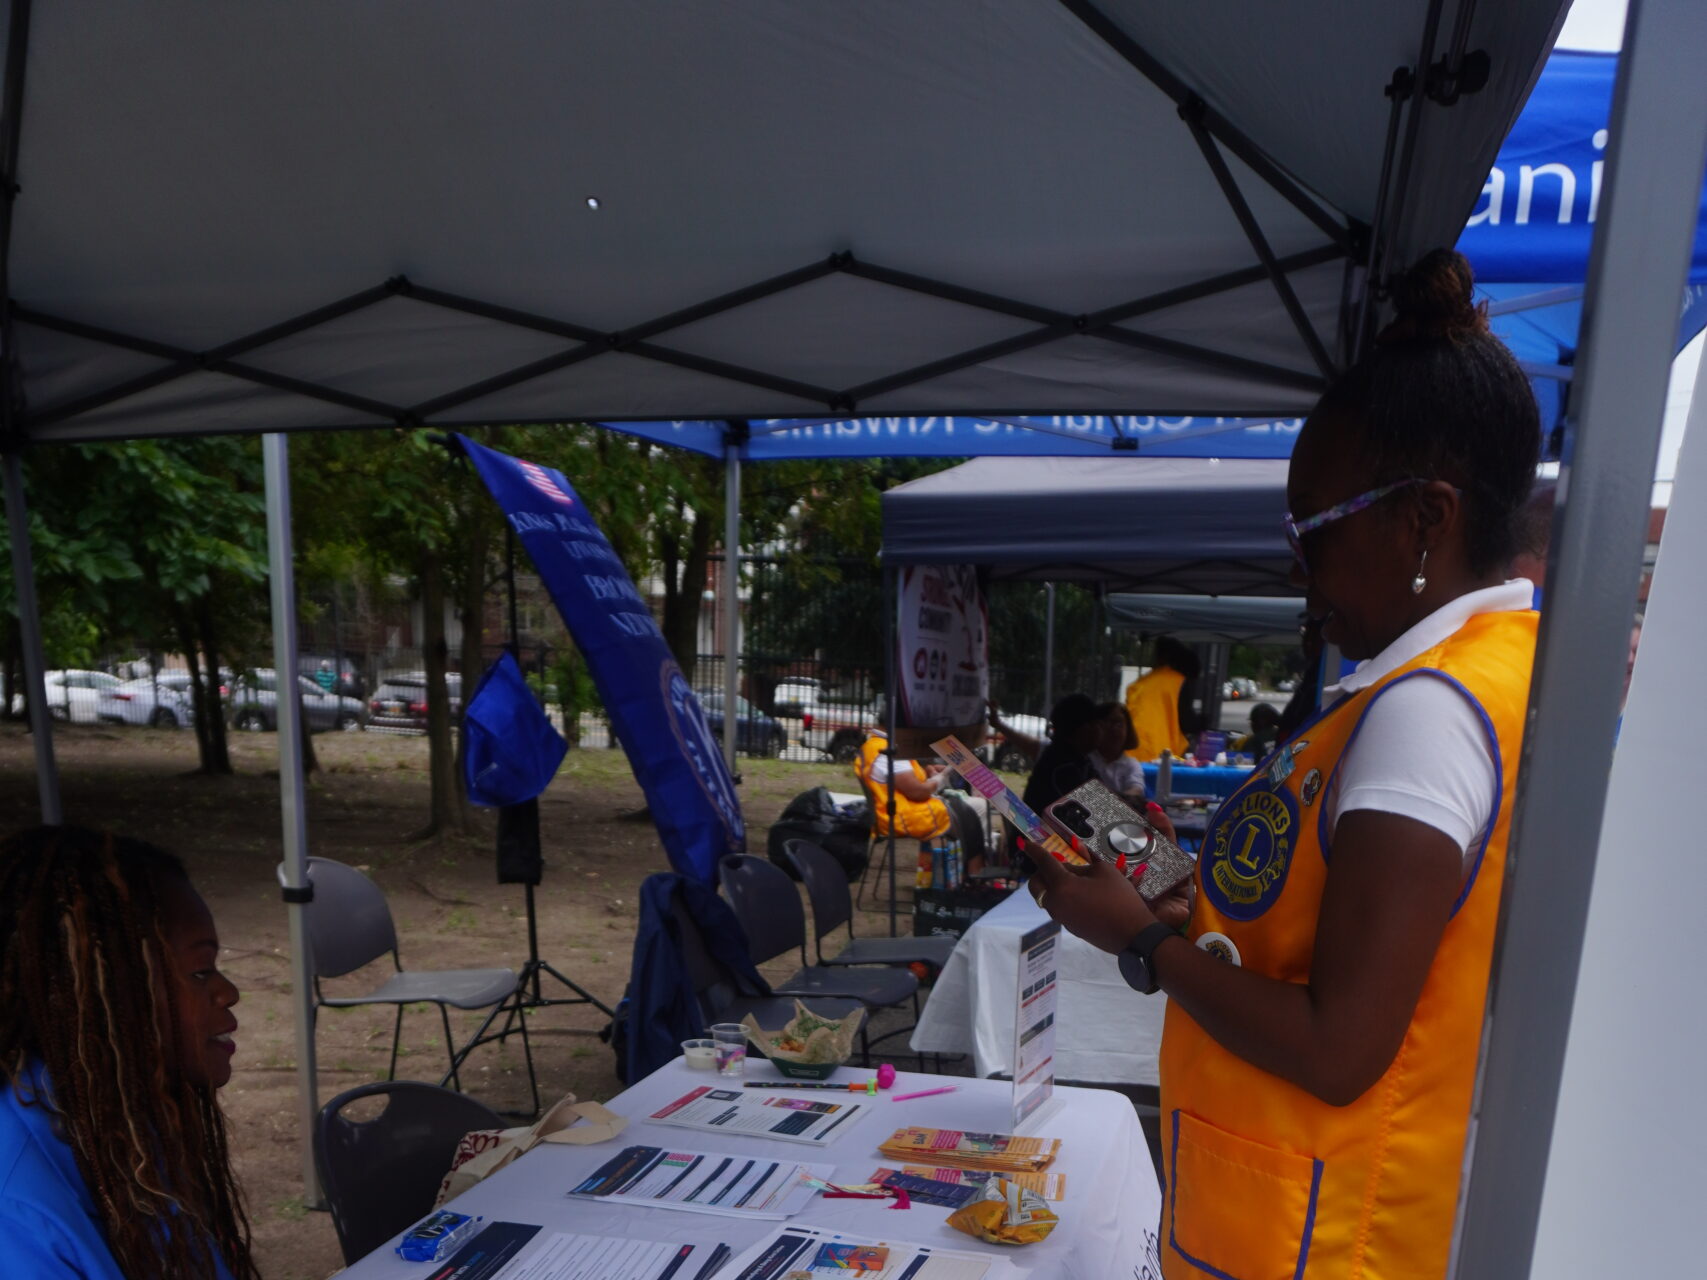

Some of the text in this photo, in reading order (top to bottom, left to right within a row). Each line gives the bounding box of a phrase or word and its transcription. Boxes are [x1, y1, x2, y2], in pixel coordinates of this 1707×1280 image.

[1245, 793, 1288, 831] LIONS
[1235, 823, 1260, 870] L
[1215, 863, 1258, 898] INTERNATIONAL
